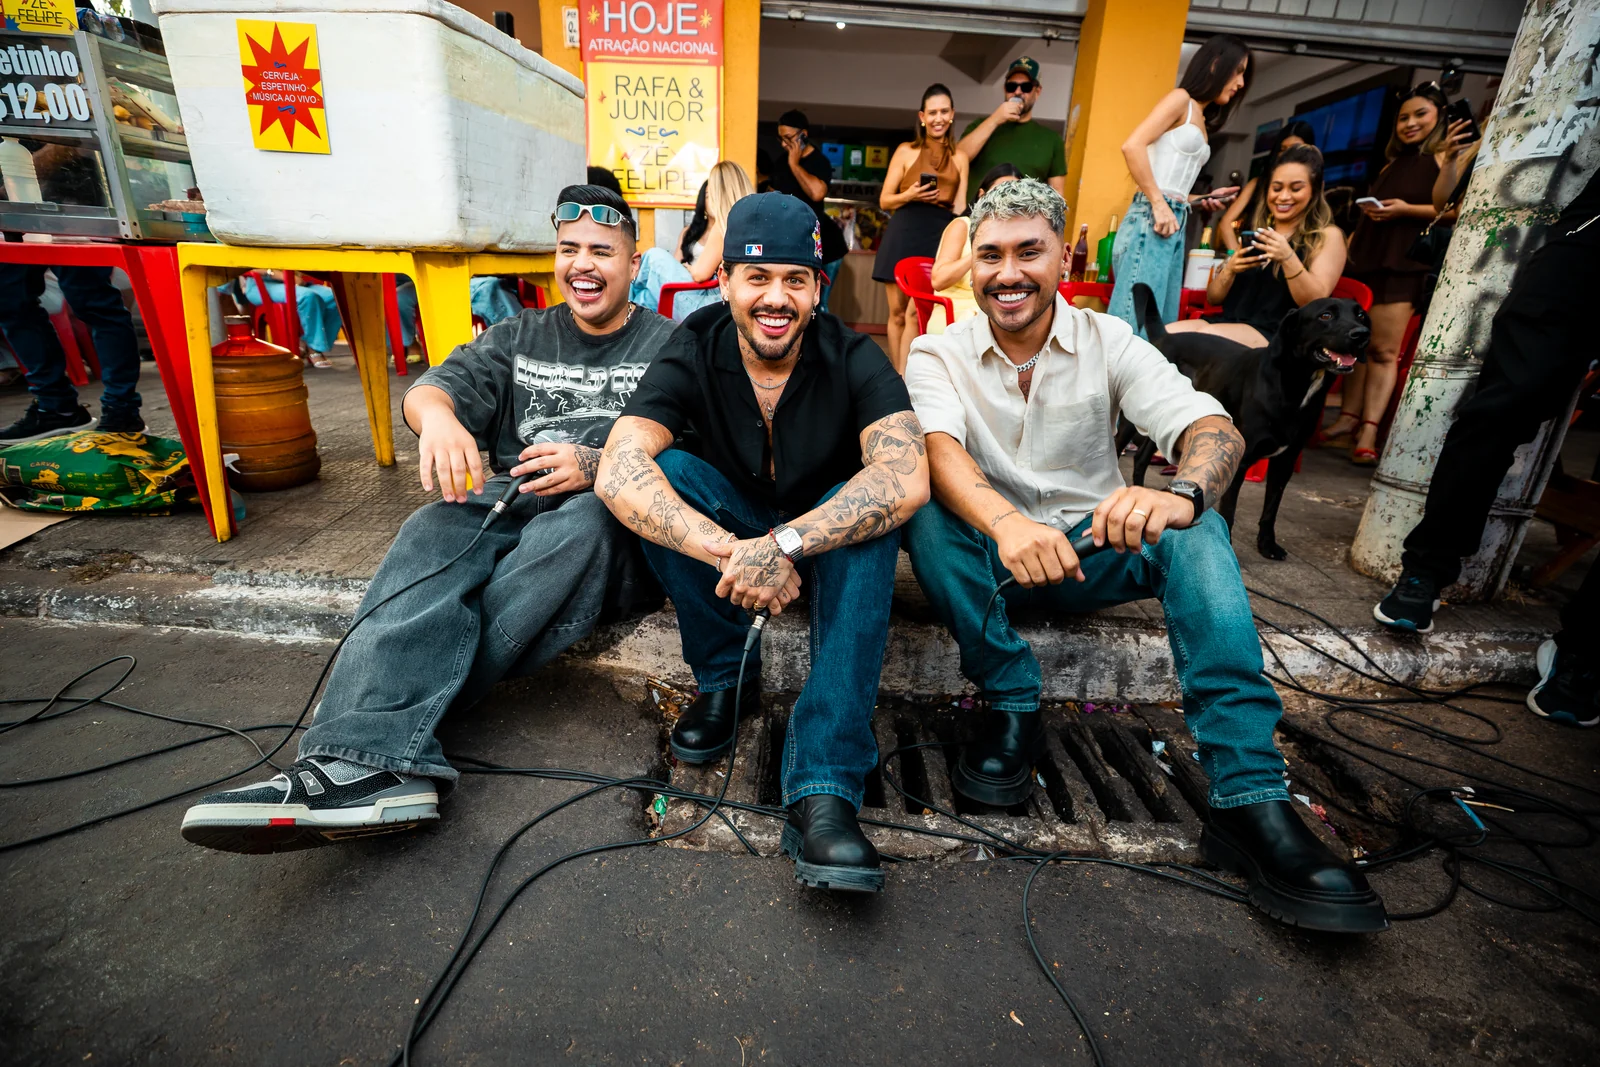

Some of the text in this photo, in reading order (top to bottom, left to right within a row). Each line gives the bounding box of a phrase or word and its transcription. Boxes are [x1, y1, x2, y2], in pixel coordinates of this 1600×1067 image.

[18, 8, 64, 24] FELIPE
[603, 1, 699, 35] HOJE
[588, 38, 650, 55] ATRAÇÃO
[653, 41, 718, 56] NACIONAL
[262, 71, 299, 81] CERVEJA
[261, 82, 307, 92] ESPETINHO
[615, 75, 704, 99] RAFA &
[252, 92, 317, 104] MÚSICA AO VIVO
[609, 99, 704, 122] JUNIOR
[647, 125, 658, 141] E
[639, 140, 669, 167] ZÉ
[30, 461, 60, 470] CARVÃO
